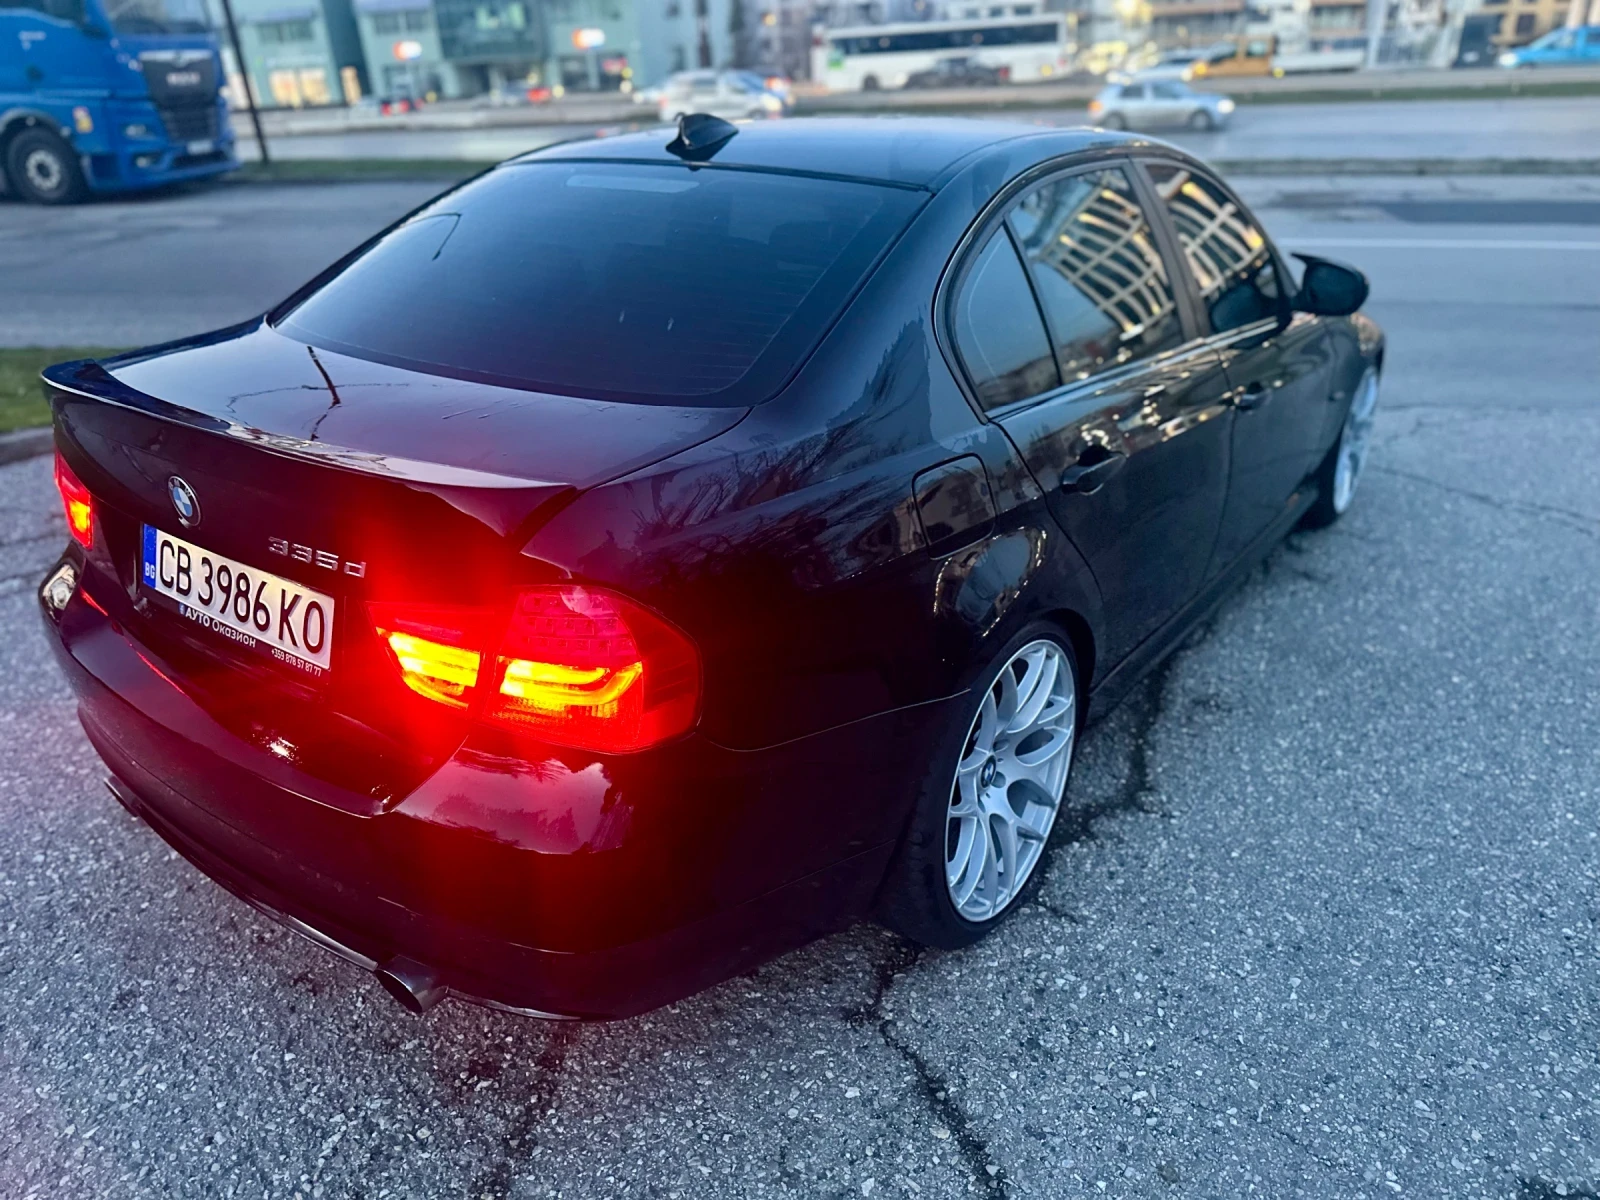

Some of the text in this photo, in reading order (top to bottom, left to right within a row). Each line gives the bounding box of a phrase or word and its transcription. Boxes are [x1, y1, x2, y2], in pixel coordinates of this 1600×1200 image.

[144, 561, 156, 579] BG
[159, 539, 325, 654] CB 3986 KO
[185, 607, 257, 649] АУТО Оказион
[313, 665, 322, 677] 77
